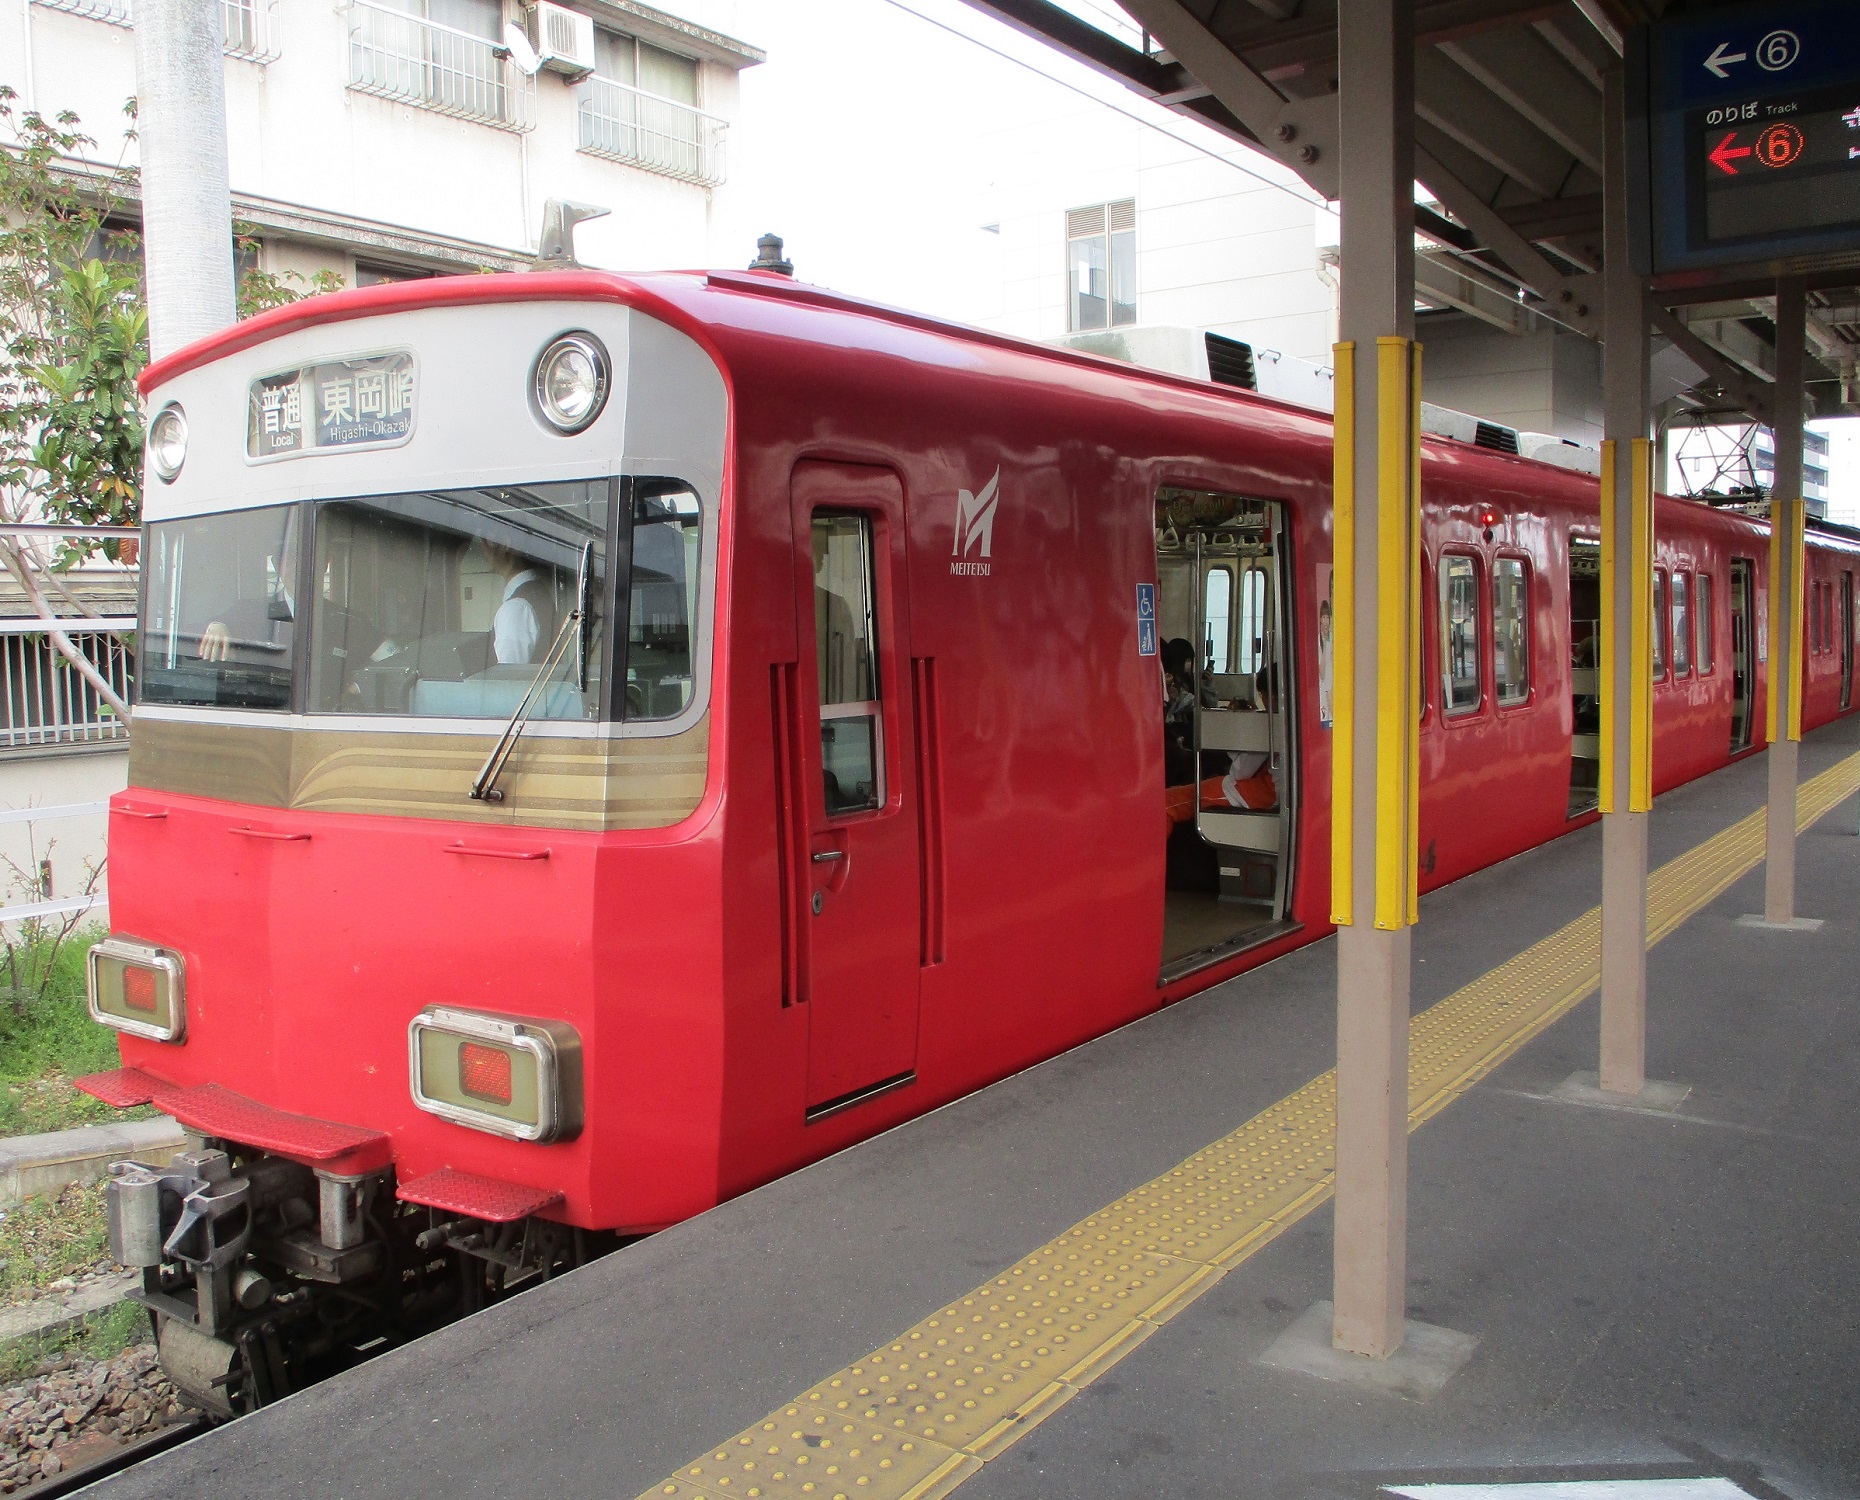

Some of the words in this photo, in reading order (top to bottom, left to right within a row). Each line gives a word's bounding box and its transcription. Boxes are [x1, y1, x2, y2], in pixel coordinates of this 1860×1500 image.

[1706, 101, 1759, 125] のりば
[1765, 102, 1798, 116] Track
[322, 366, 414, 426] 東岡崎
[262, 384, 301, 435] 普通
[271, 434, 294, 448] Local
[950, 562, 991, 576] MEITETSU
